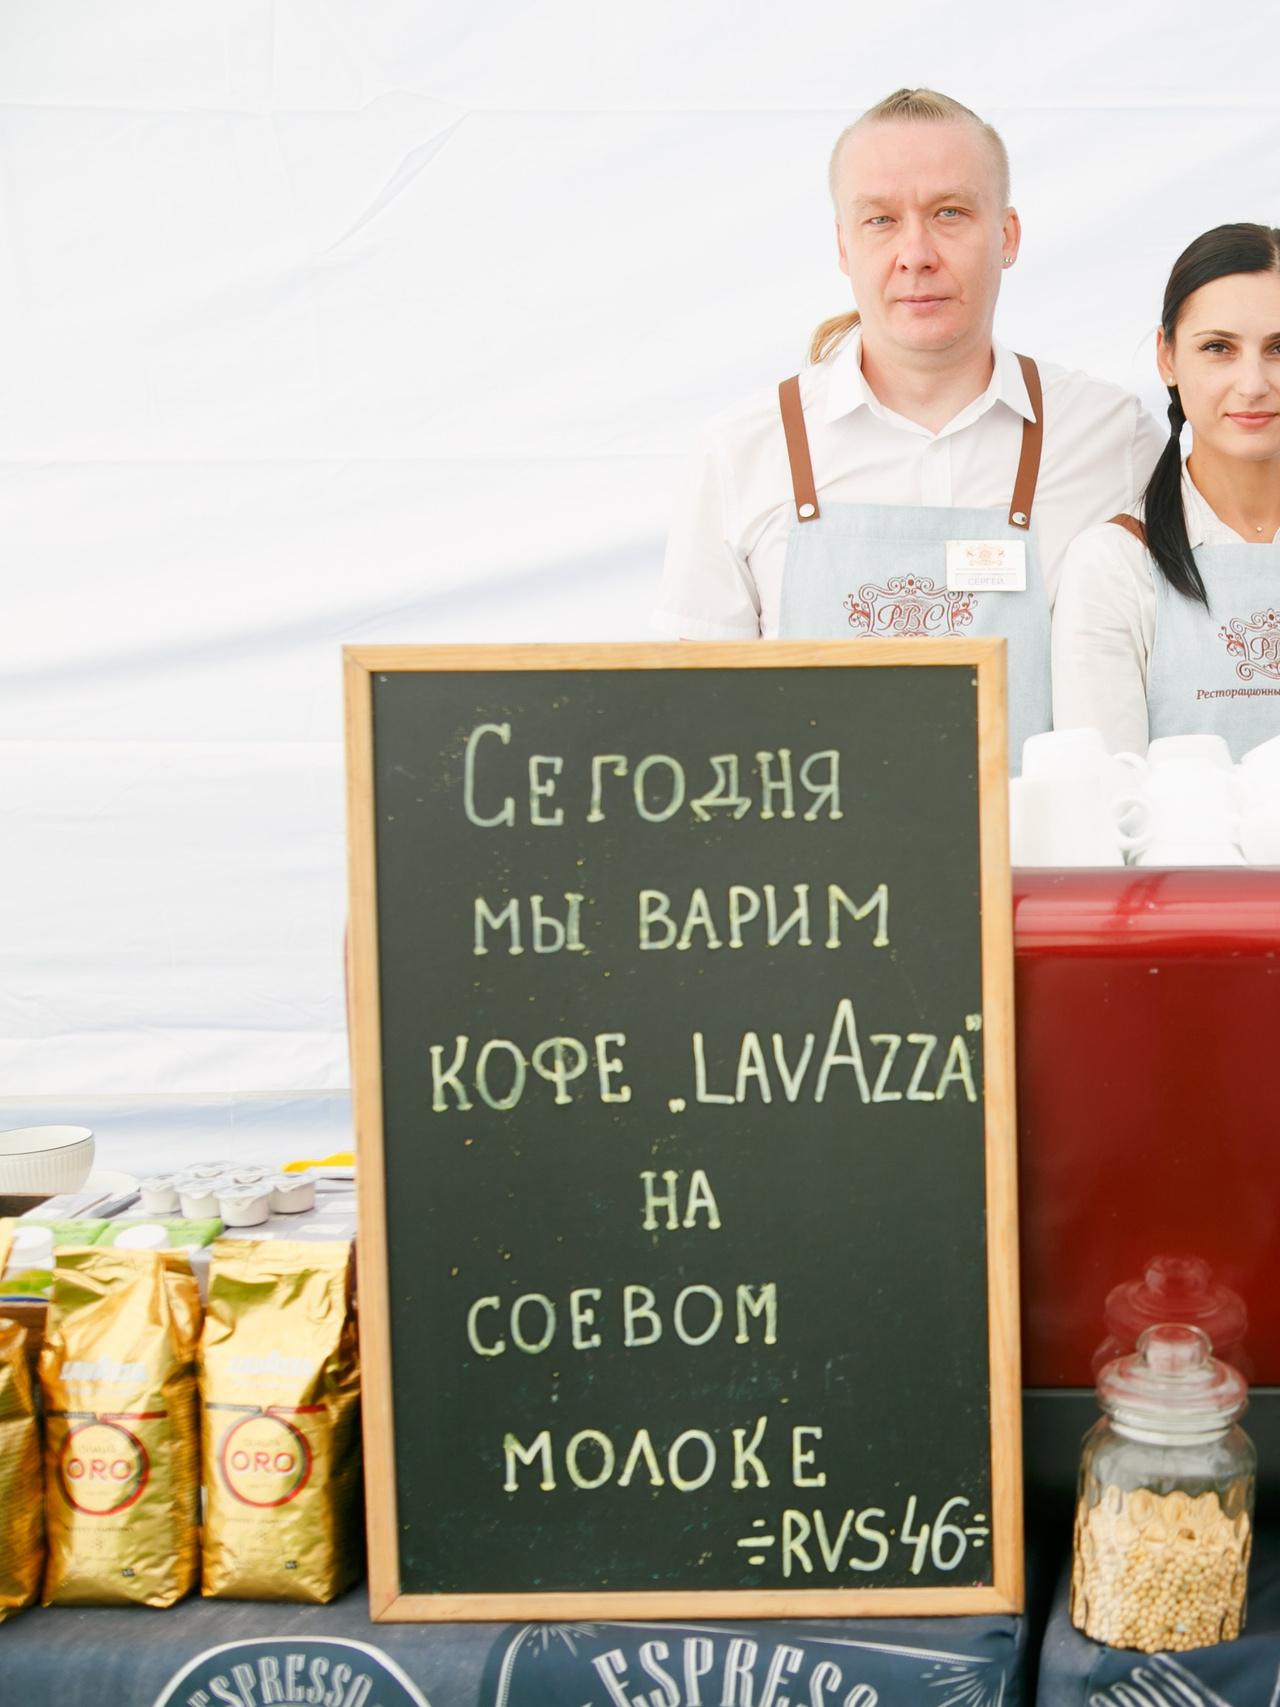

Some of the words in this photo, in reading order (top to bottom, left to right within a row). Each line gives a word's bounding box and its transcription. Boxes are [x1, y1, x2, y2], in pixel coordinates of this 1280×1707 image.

[968, 577, 1004, 586] СЕРГЕЙ
[639, 884, 888, 950] ВАРИМ
[429, 1034, 631, 1112] КОФЕ
[639, 1169, 721, 1230] НА
[467, 1282, 777, 1356] СОЕВОМ
[66, 1457, 133, 1482] ORO
[231, 1450, 296, 1474] ORO
[503, 1415, 826, 1492] МОЛОКЕ
